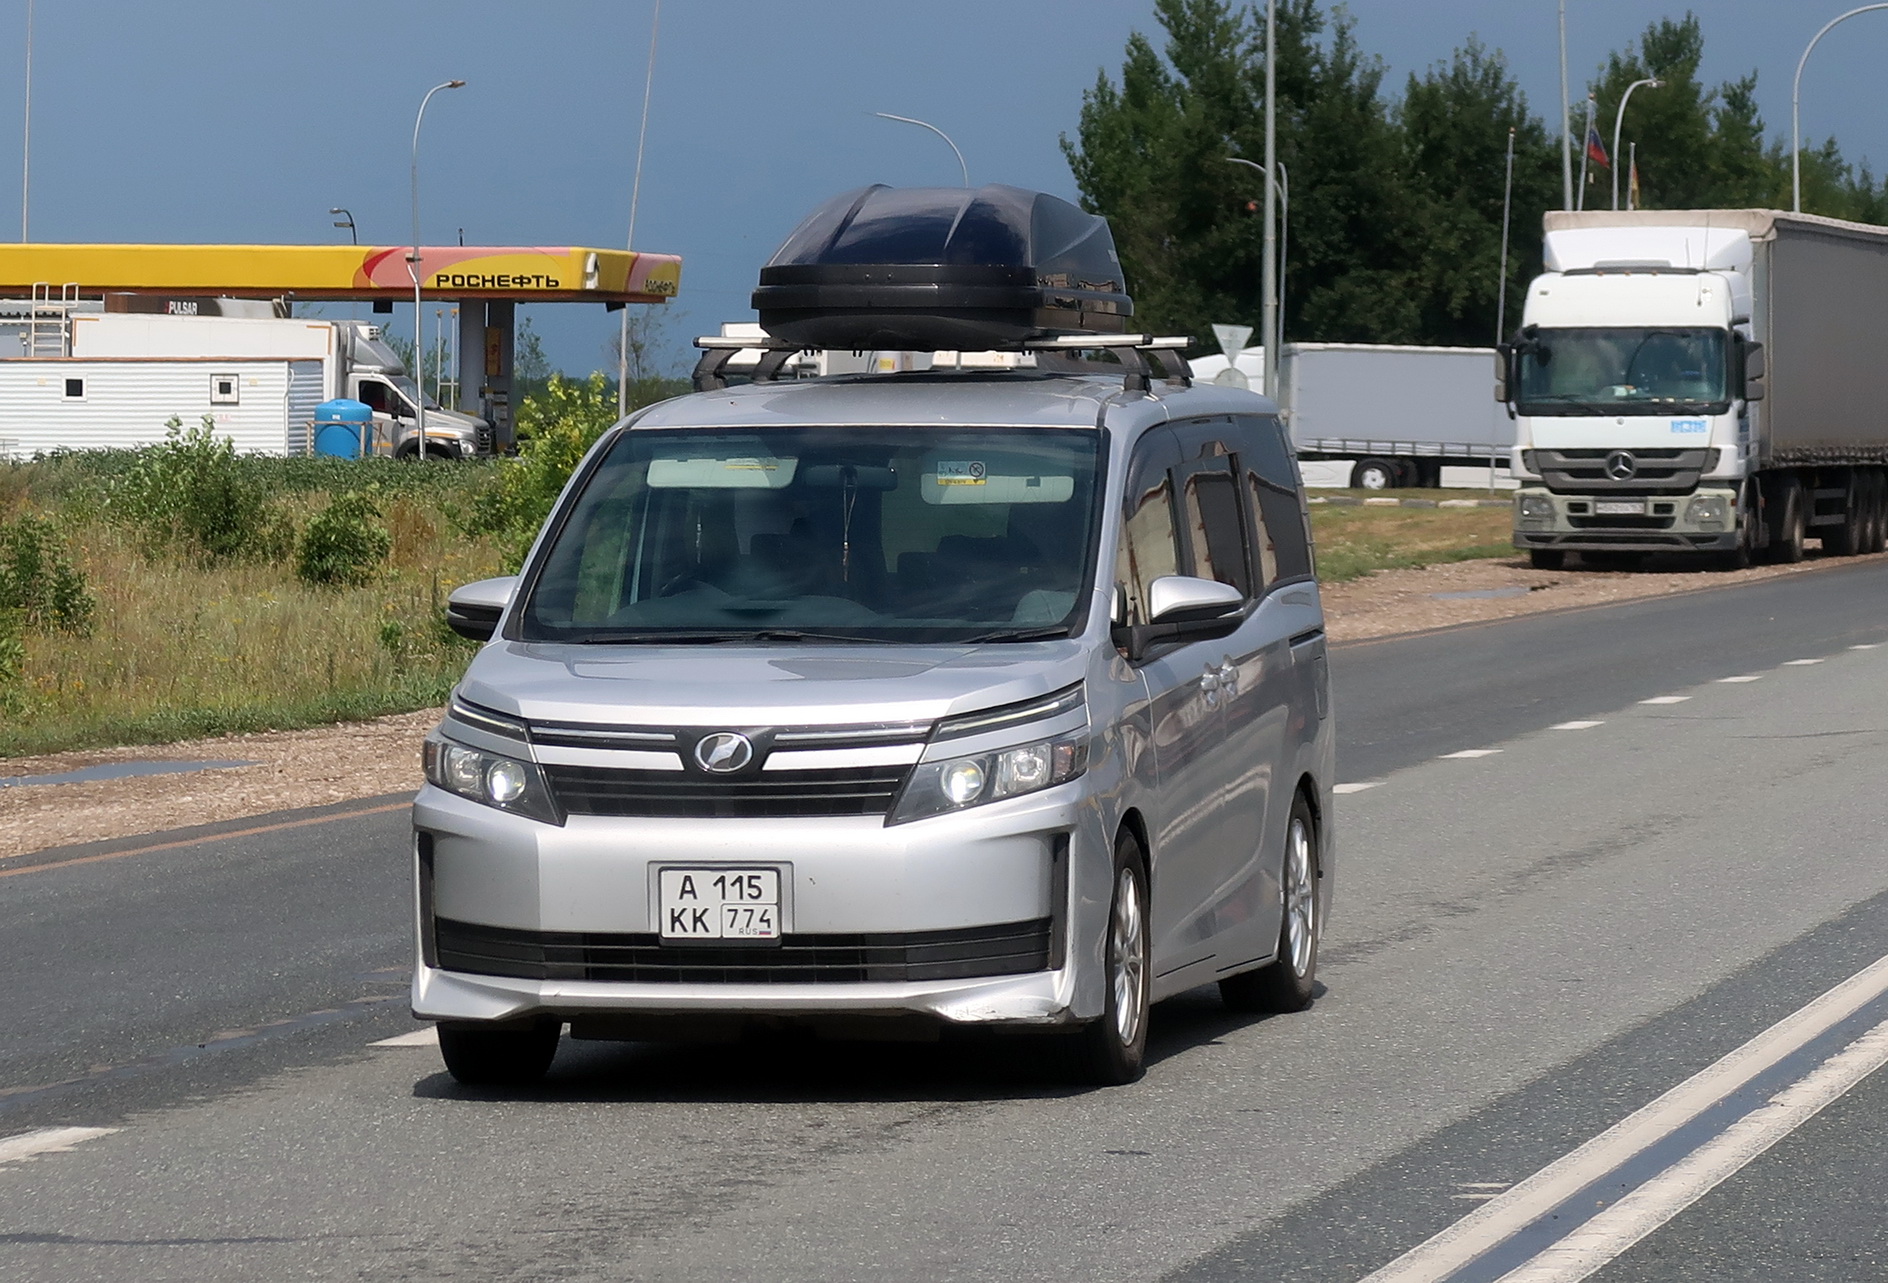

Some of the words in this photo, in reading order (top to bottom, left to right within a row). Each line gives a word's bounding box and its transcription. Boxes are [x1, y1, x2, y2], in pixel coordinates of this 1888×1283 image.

[436, 274, 560, 288] РОСНЕФТЬ
[169, 300, 198, 315] PULSAR
[712, 875, 762, 900] 115
[727, 908, 771, 929] 774
[738, 927, 758, 935] RUS
